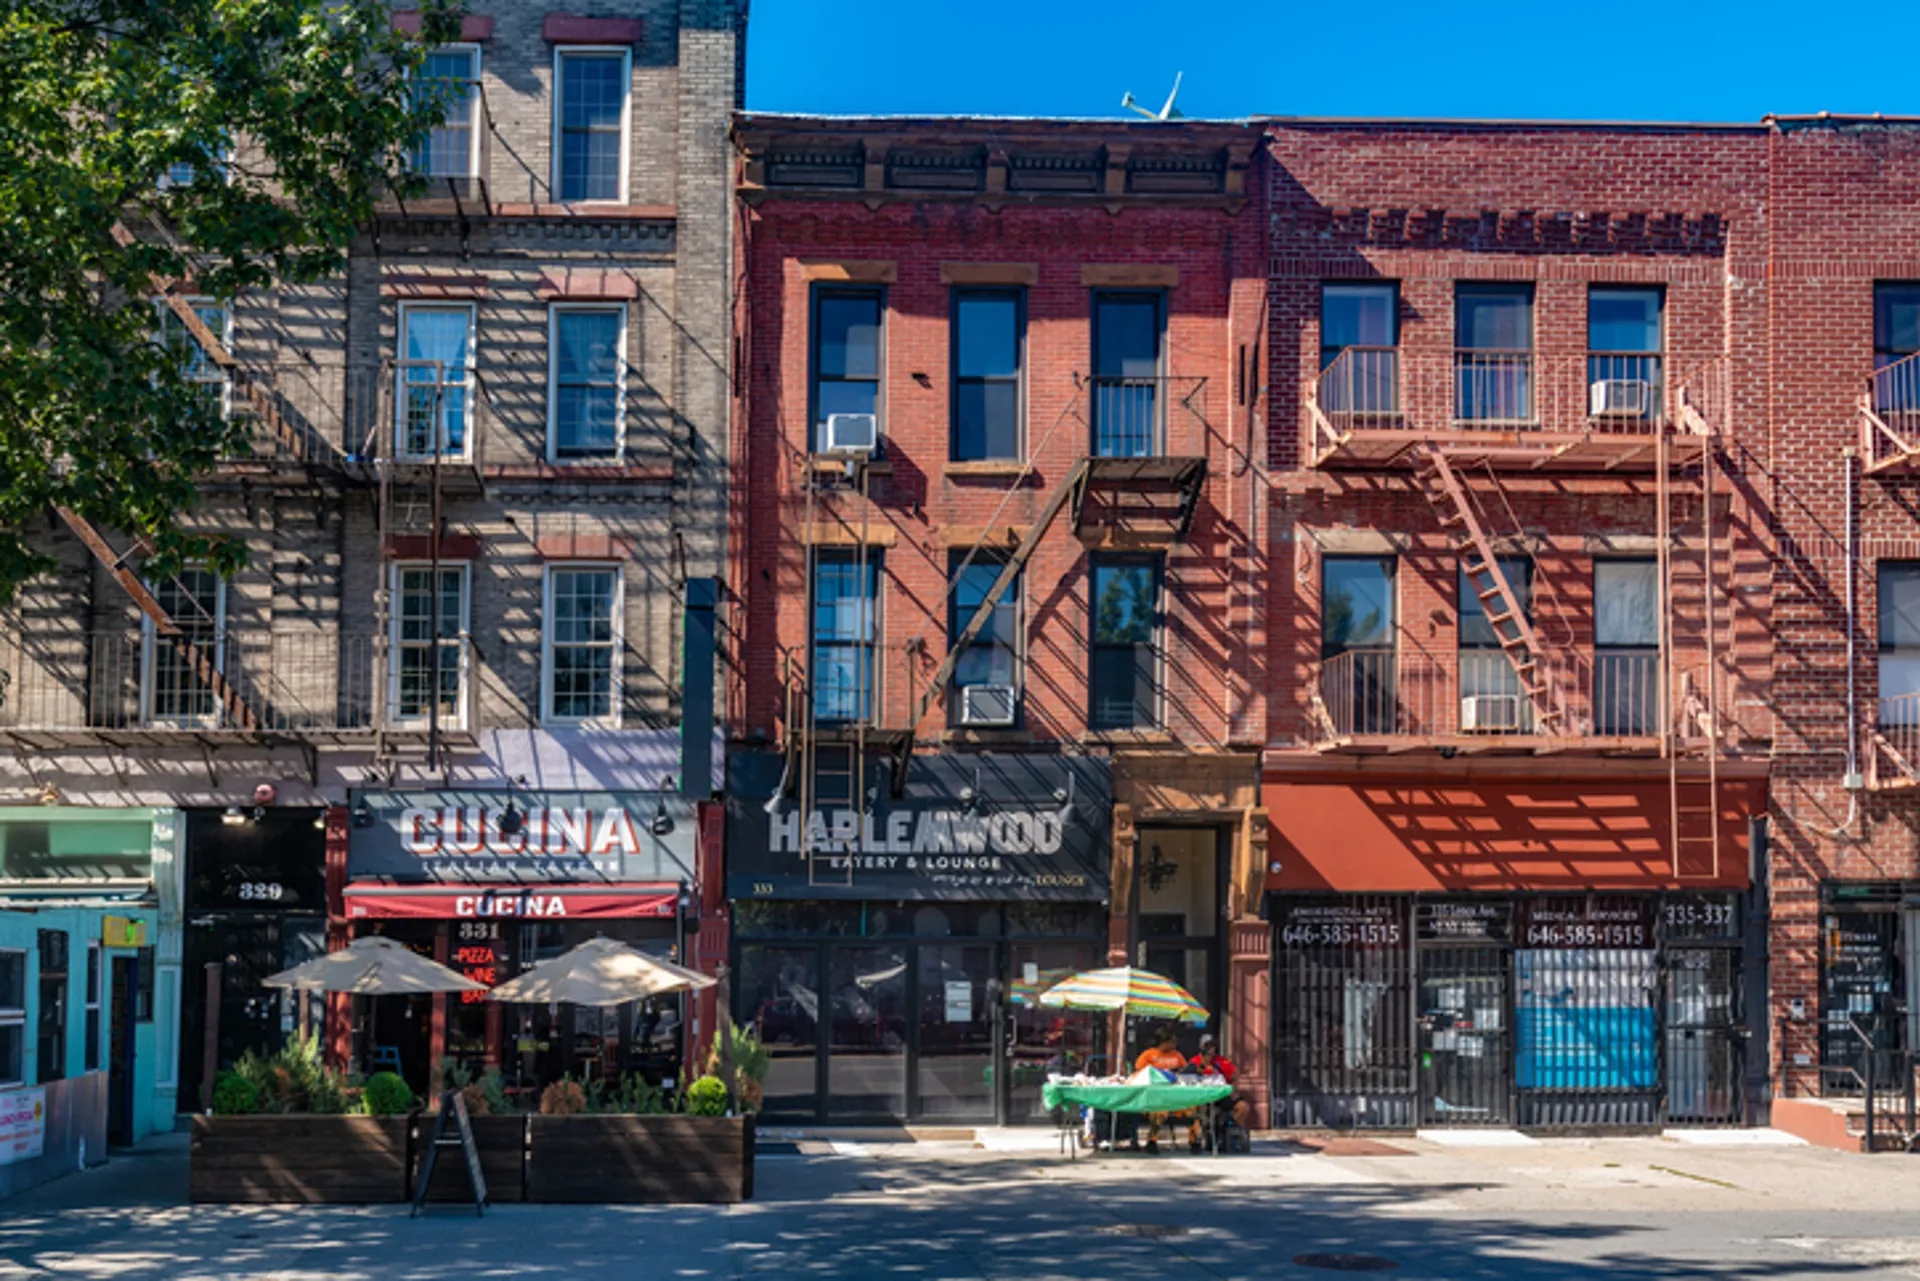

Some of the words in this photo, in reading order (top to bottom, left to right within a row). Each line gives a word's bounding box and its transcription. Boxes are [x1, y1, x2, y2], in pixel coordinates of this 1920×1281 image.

[400, 806, 640, 855] CUCINA
[768, 810, 1063, 855] HARLEMWOOD
[831, 856, 898, 869] EATERY
[906, 857, 920, 869] &
[926, 857, 1001, 869] LOUNGE
[238, 882, 283, 900] 329
[455, 896, 566, 916] CUCINA
[1665, 903, 1733, 925] 335-337
[458, 922, 500, 940] 331
[1282, 925, 1400, 944] 646-585-1515
[1527, 925, 1644, 945] 646-585-1515
[458, 946, 495, 964] PIZZA
[462, 967, 497, 985] WINE
